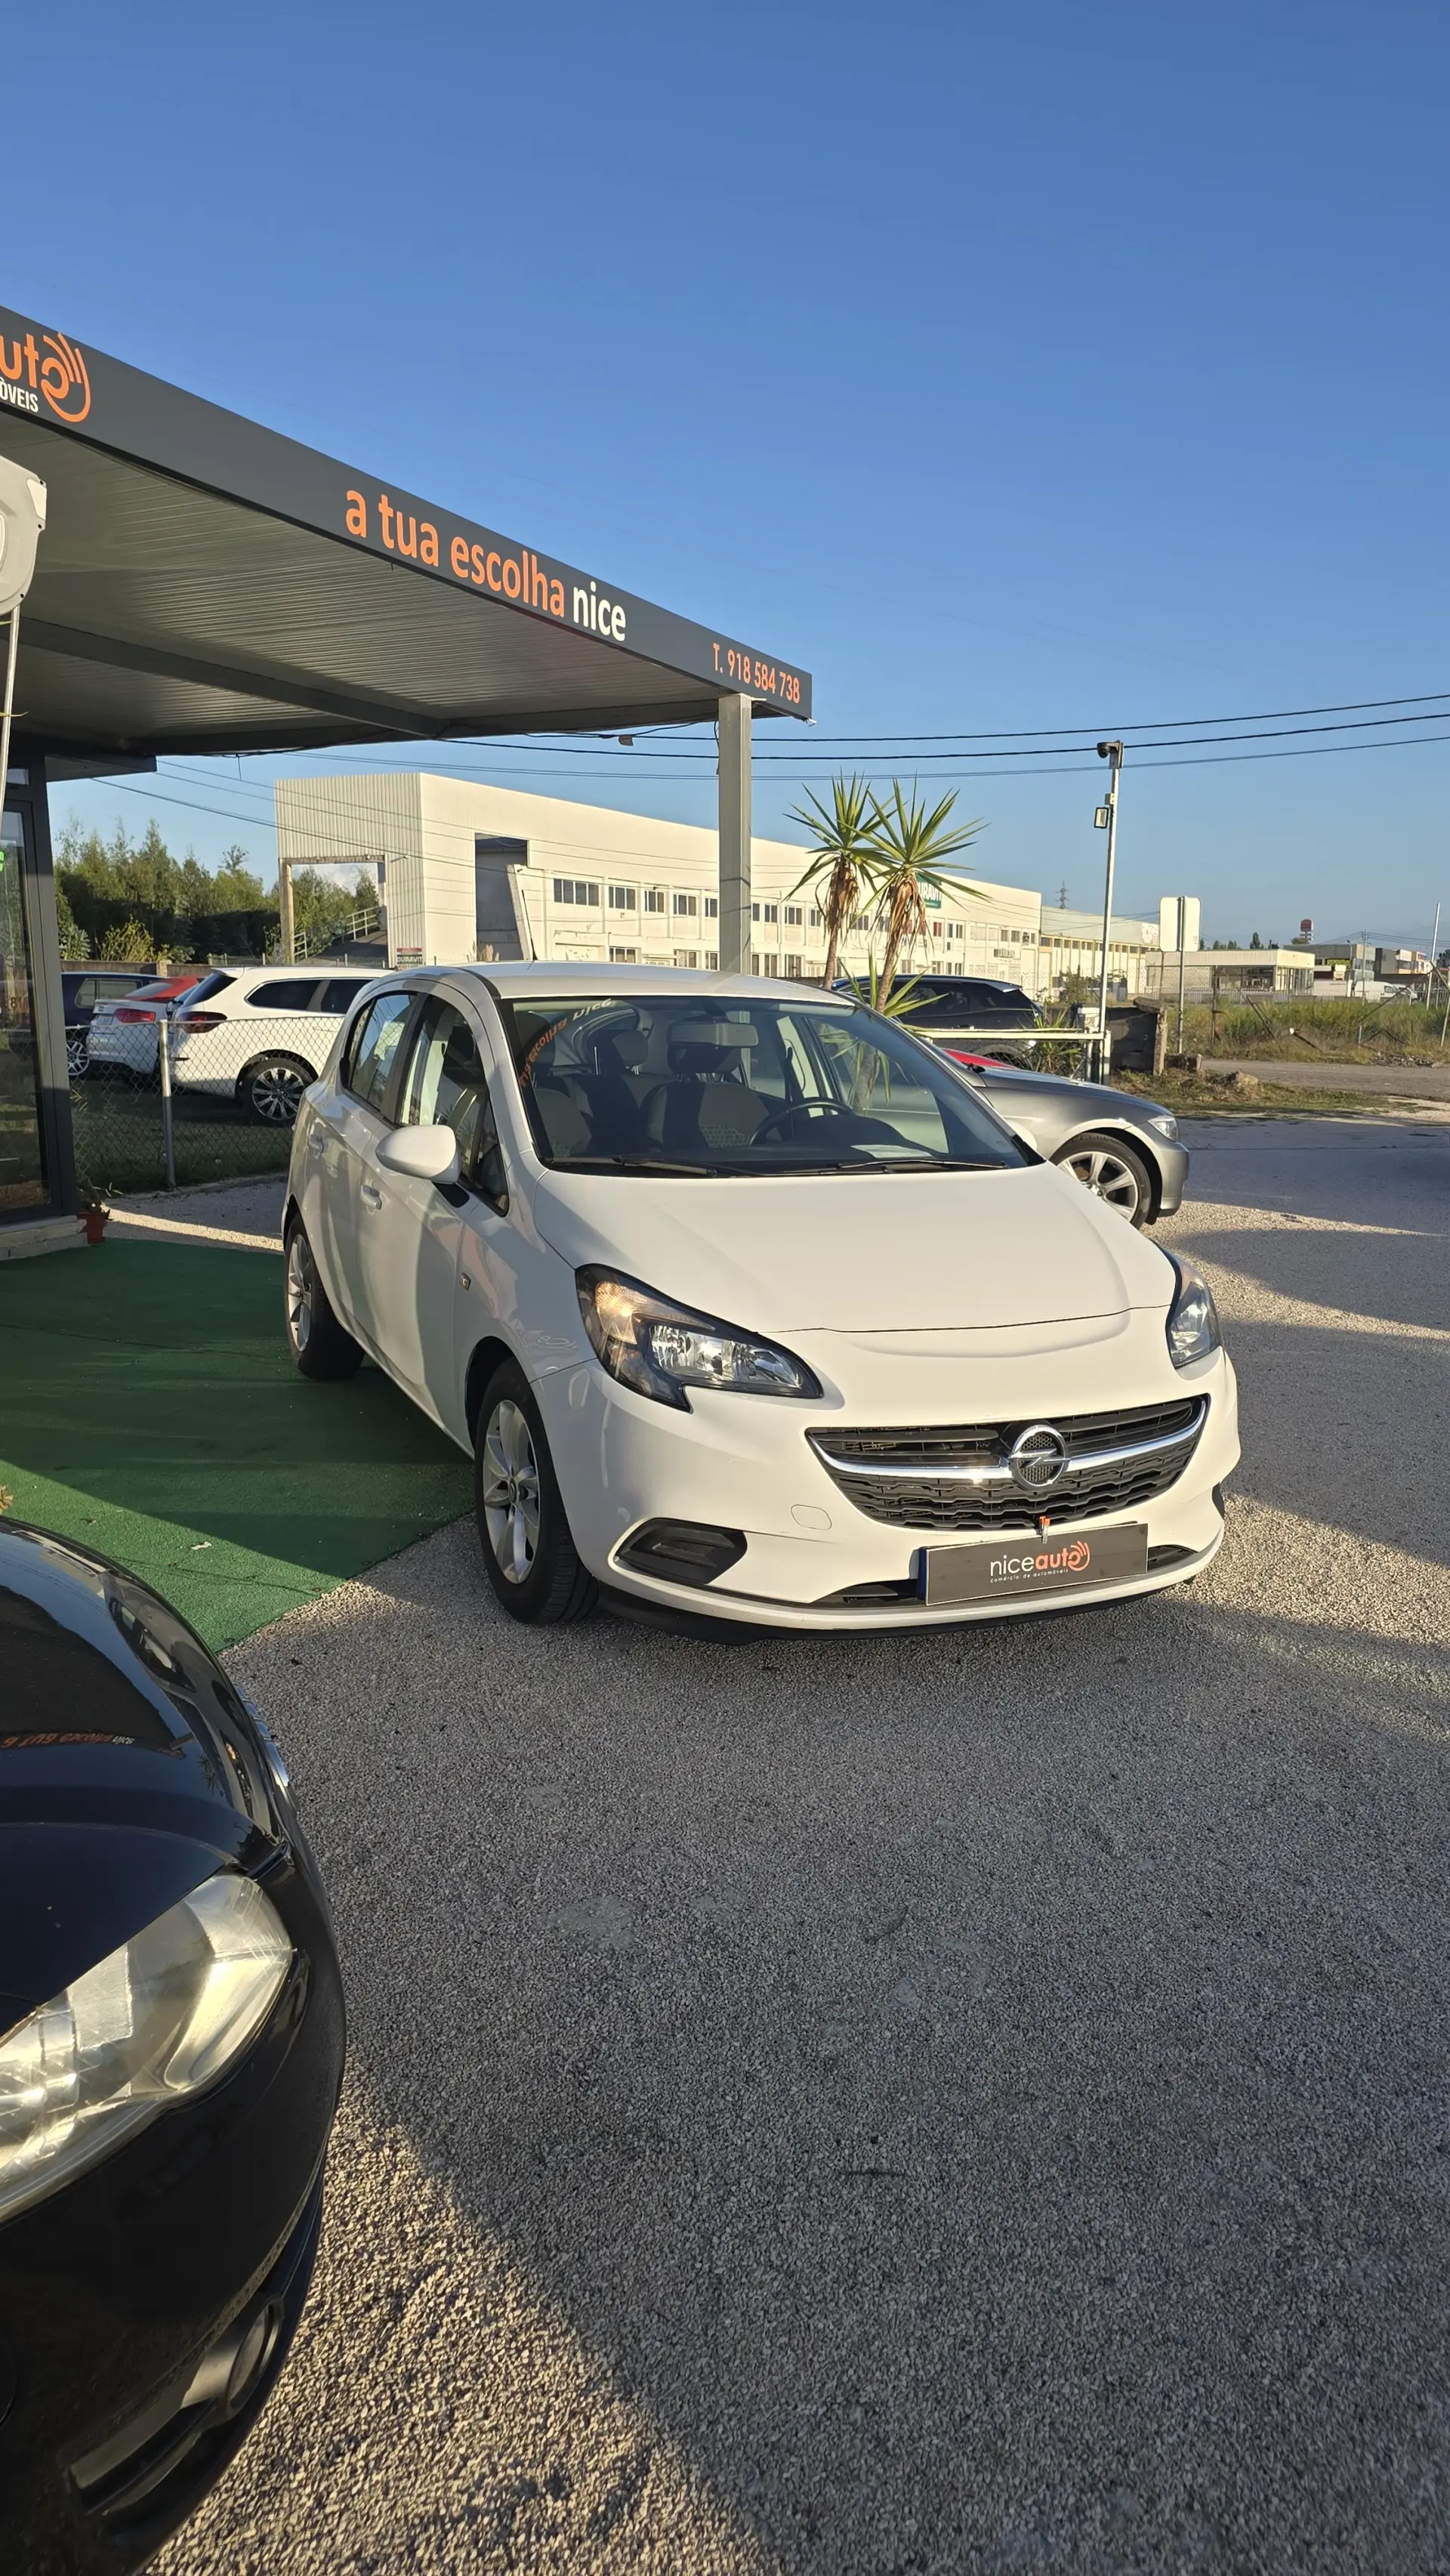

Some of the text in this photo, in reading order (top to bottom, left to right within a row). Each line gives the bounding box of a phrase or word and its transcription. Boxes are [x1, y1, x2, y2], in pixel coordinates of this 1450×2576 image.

[346, 490, 626, 641] a tua escolha nice
[713, 642, 801, 704] T. 918 584 738
[1033, 1568, 1069, 1577] automóveis
